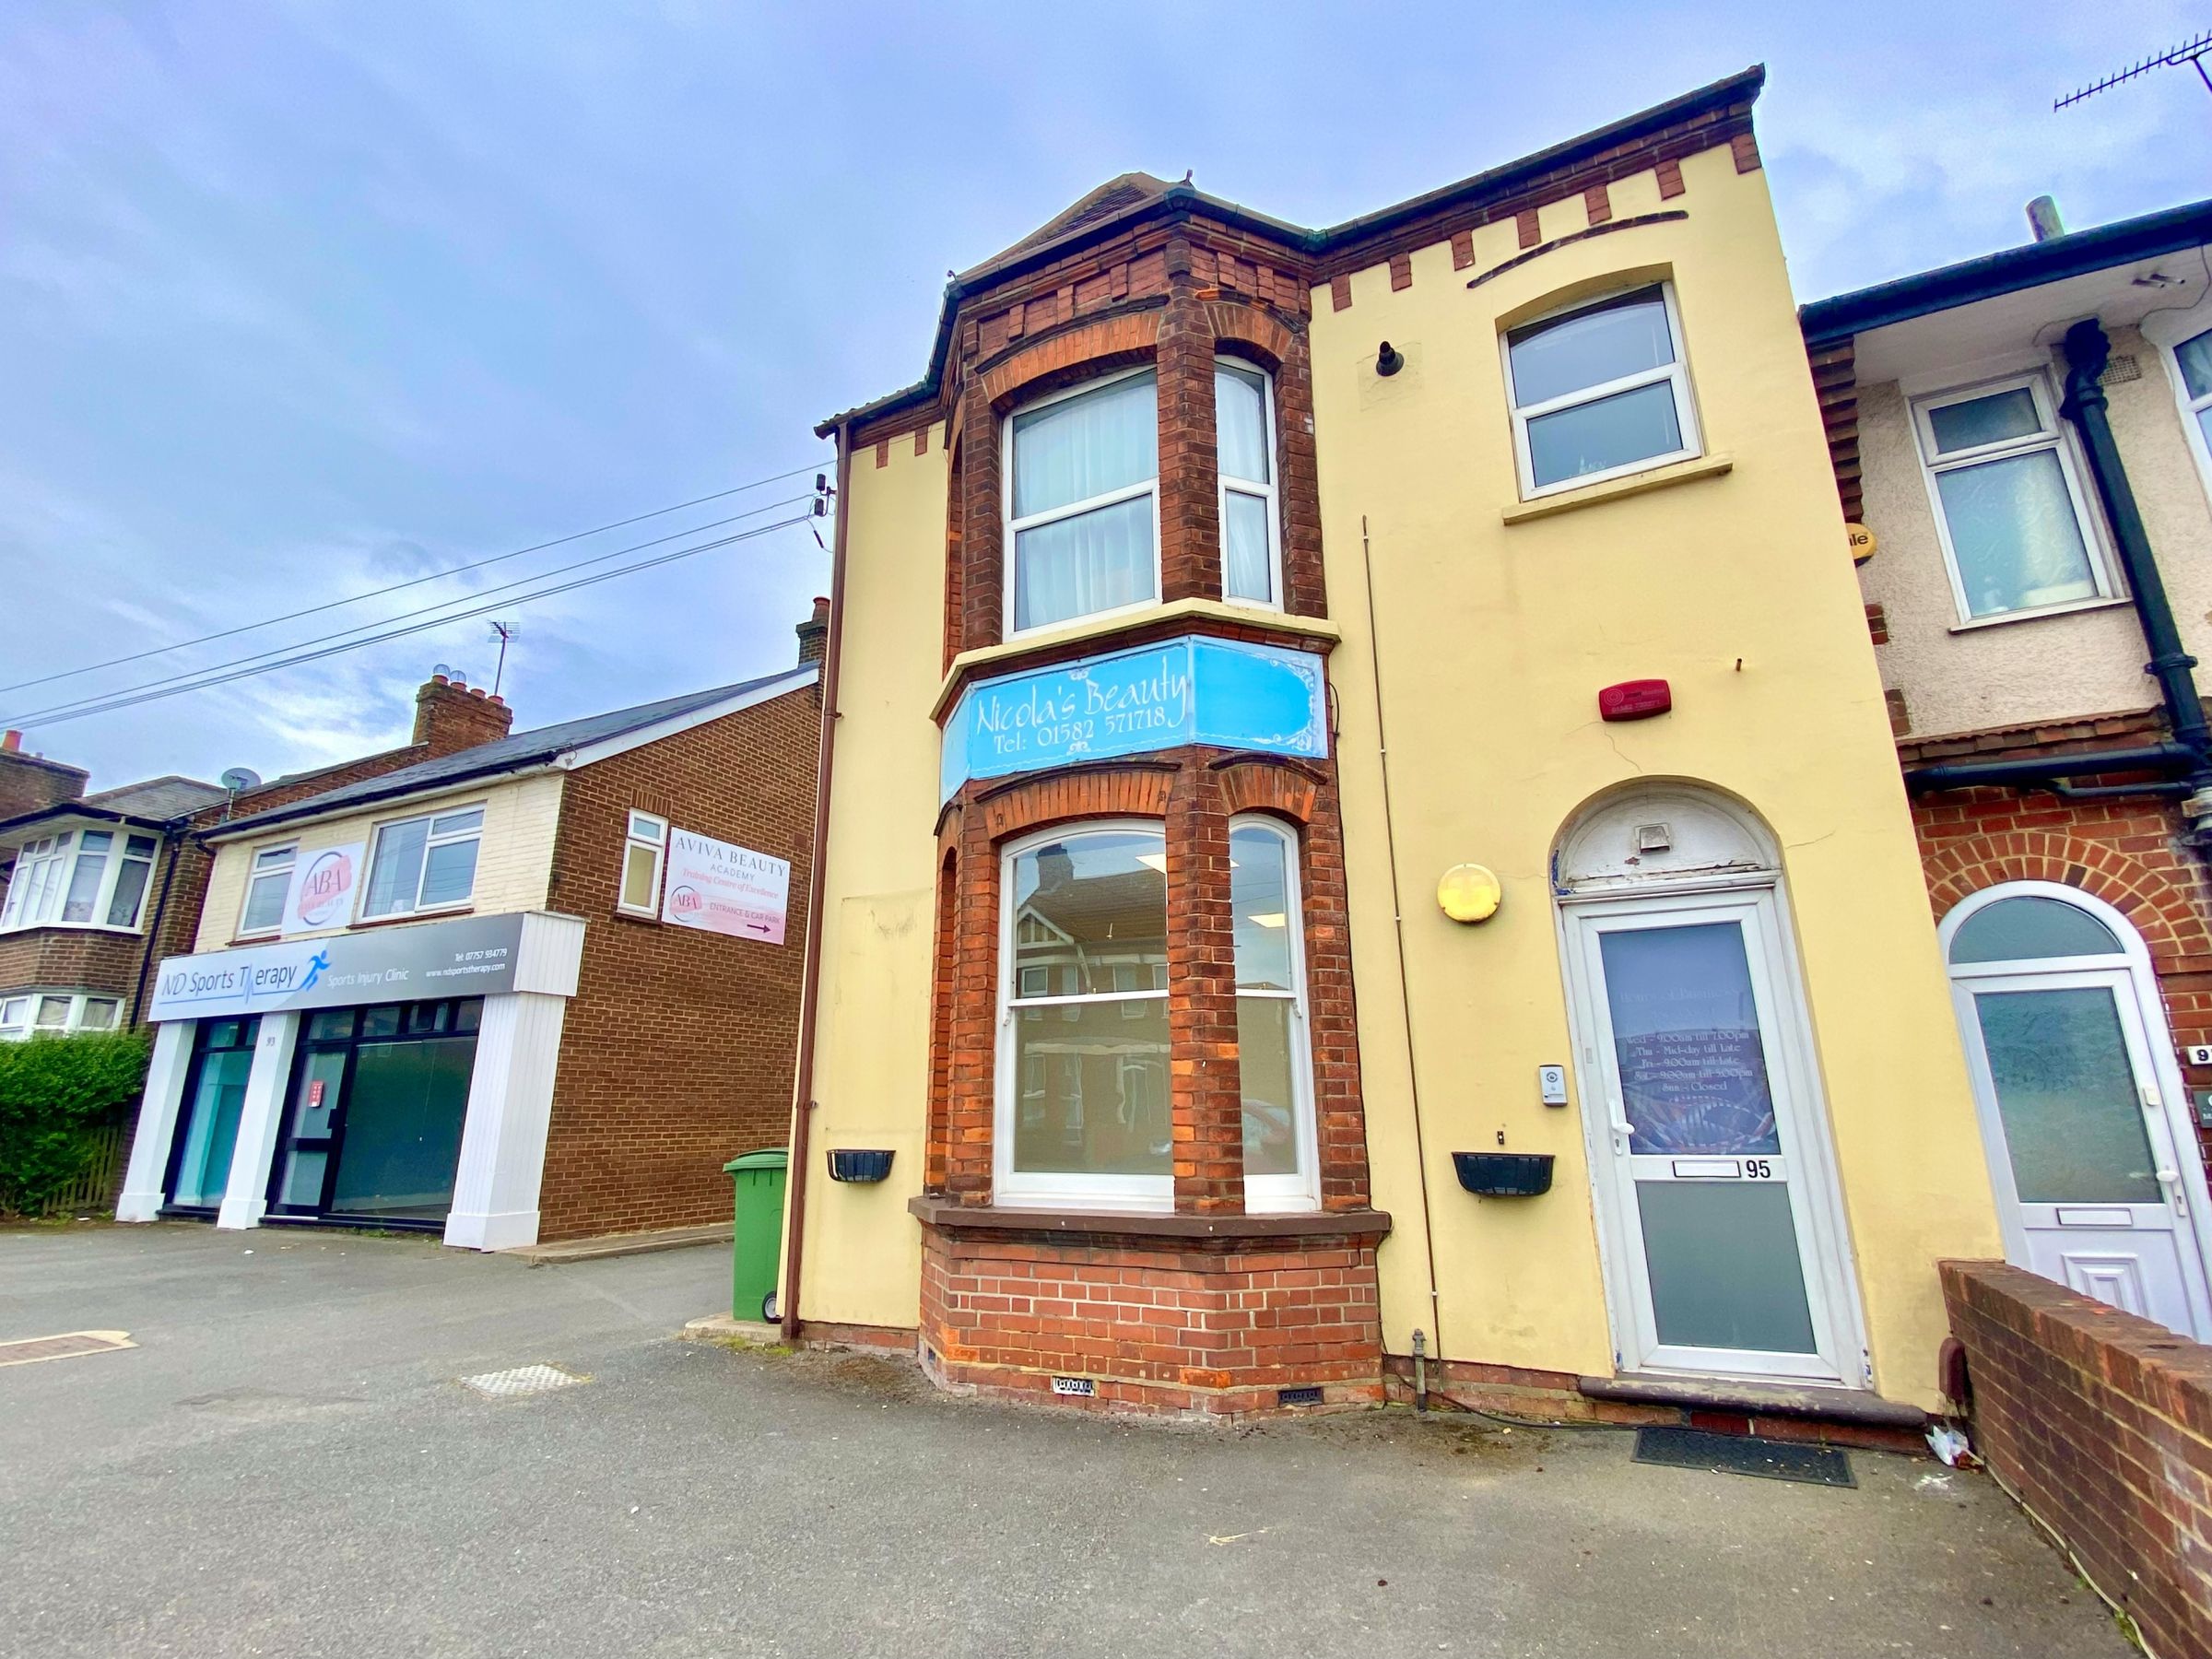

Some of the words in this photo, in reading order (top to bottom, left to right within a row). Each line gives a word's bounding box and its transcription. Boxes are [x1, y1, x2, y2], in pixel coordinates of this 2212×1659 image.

[977, 684, 1076, 735] Nicola's
[1084, 655, 1187, 728] Beauty
[994, 733, 1027, 754] Tel:
[1037, 719, 1094, 747] 01582
[1105, 706, 1165, 735] 571718
[676, 836, 724, 860] AVIVA
[729, 851, 786, 877] BEAUTY
[304, 869, 341, 897] ABA
[682, 868, 712, 883] Training
[737, 883, 747, 893] of
[746, 884, 779, 900] Excellence
[710, 864, 755, 880] ACADEMY
[673, 892, 698, 910] ABA
[710, 901, 745, 917] ENTRANCE
[751, 912, 764, 920] CAR
[765, 915, 781, 924] PARK
[161, 972, 187, 996] ND
[189, 971, 234, 996] Sports
[327, 974, 355, 989] Sports
[357, 971, 383, 987] Injury
[385, 967, 409, 982] Clinic
[2196, 1048, 2212, 1062] 9
[1746, 1159, 1771, 1179] 95
